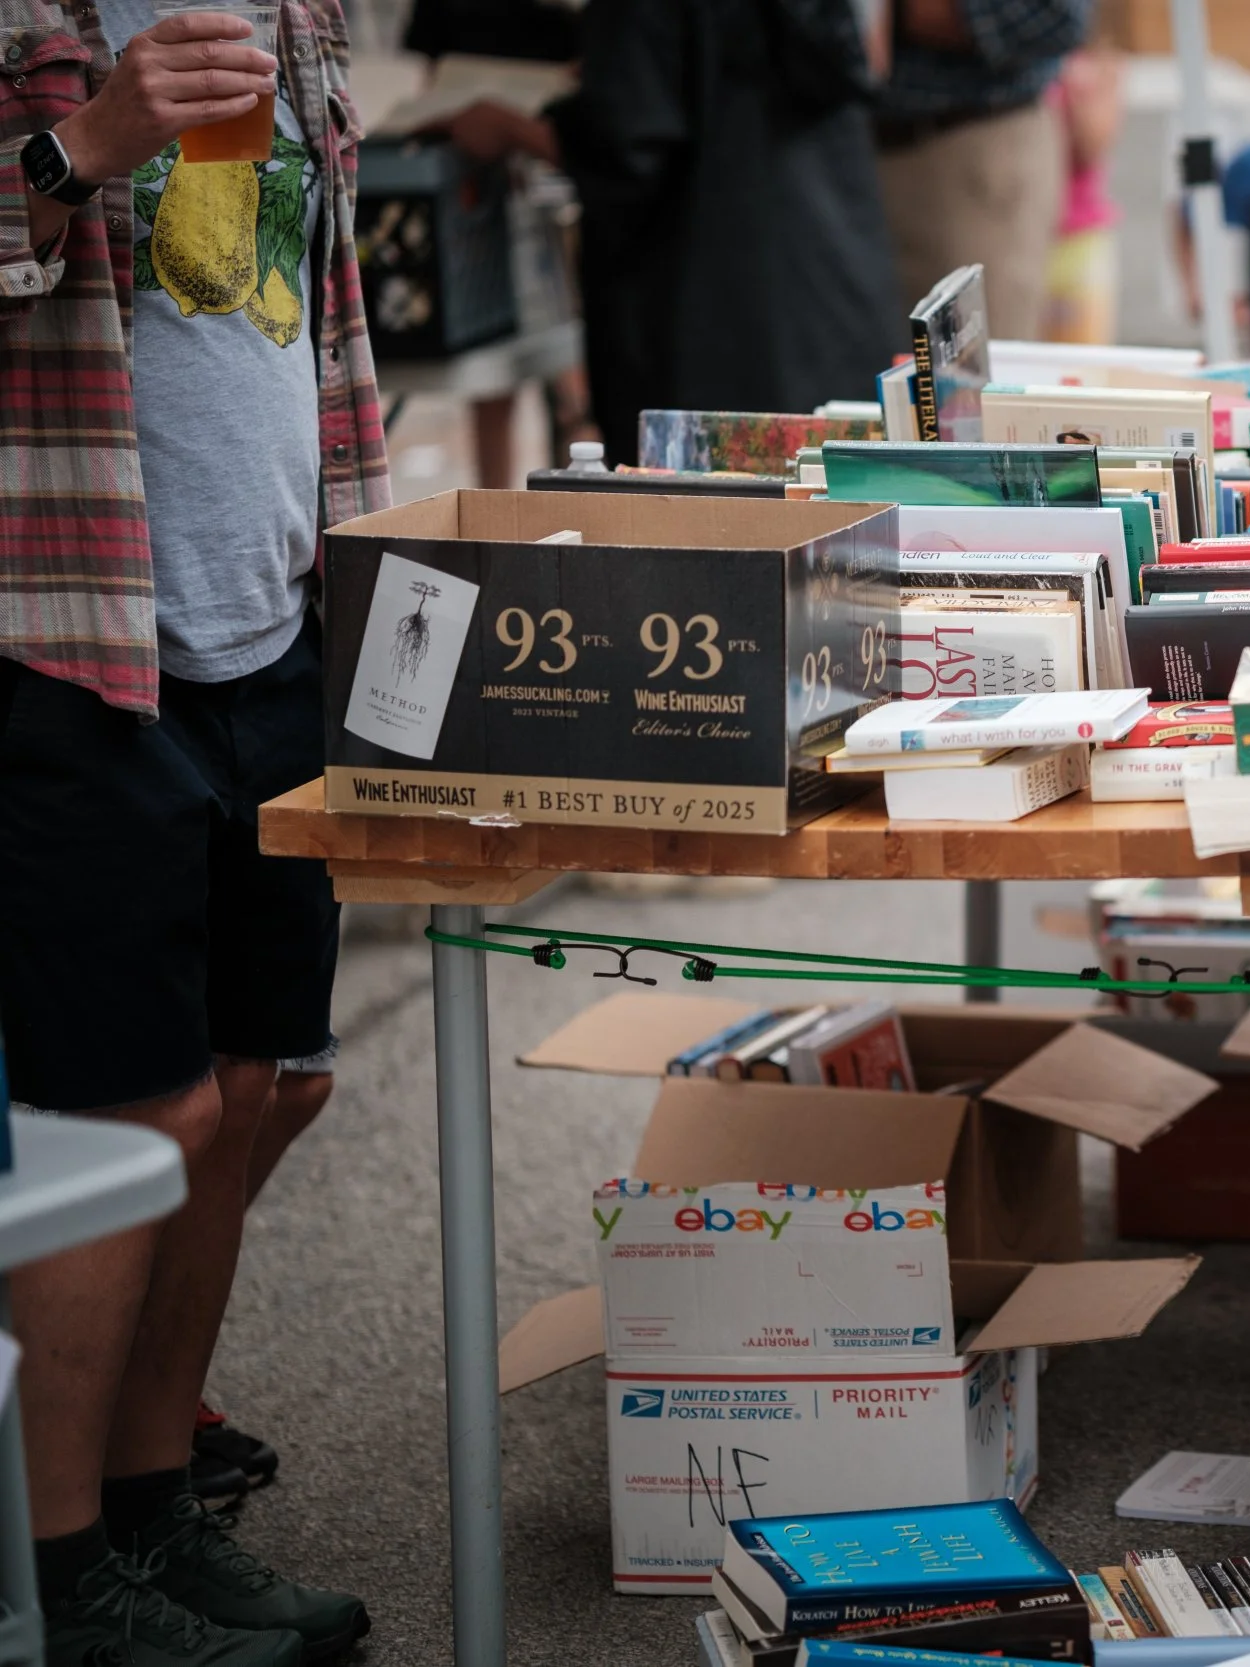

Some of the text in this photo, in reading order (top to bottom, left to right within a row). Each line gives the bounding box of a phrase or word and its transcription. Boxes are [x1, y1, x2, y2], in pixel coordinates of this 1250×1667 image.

[913, 334, 931, 371] THE
[495, 607, 578, 673] 93
[640, 613, 724, 680] 93
[861, 619, 887, 691] 93
[802, 645, 831, 719] 93
[369, 687, 427, 715] METHOD
[480, 685, 600, 703] JAMESSUCKLING.COM
[634, 689, 746, 713] WINE ENTHUSIAST
[535, 708, 579, 718] VINTAGE
[632, 718, 752, 739] Editor's Choice
[940, 731, 973, 745] what
[984, 729, 1014, 742] wish
[1018, 727, 1037, 740] for
[1040, 728, 1066, 742] you
[1112, 763, 1124, 773] IN
[1128, 763, 1150, 773] THE
[353, 778, 476, 807] WINE ENTHUSIAST
[502, 790, 756, 822] #1 BEST BUY of 2025
[675, 1199, 792, 1240] ebay
[761, 1327, 794, 1336] MAIL
[830, 1328, 910, 1338] POSTAL SERVICE
[747, 1336, 809, 1347] PRIORITY
[833, 1338, 908, 1347] UNITED STATES
[671, 1389, 788, 1402] UNITED STATES
[832, 1387, 931, 1403] PRIORITY
[668, 1406, 793, 1421] POSTAL SERVICE
[857, 1406, 909, 1419] MAIL
[625, 1474, 657, 1485] LARGE
[660, 1477, 702, 1487] MAILING
[628, 1557, 674, 1567] TRACKED
[1019, 1592, 1071, 1609] KELLEY
[791, 1609, 839, 1622] KOLATCH
[844, 1605, 880, 1620] HOW
